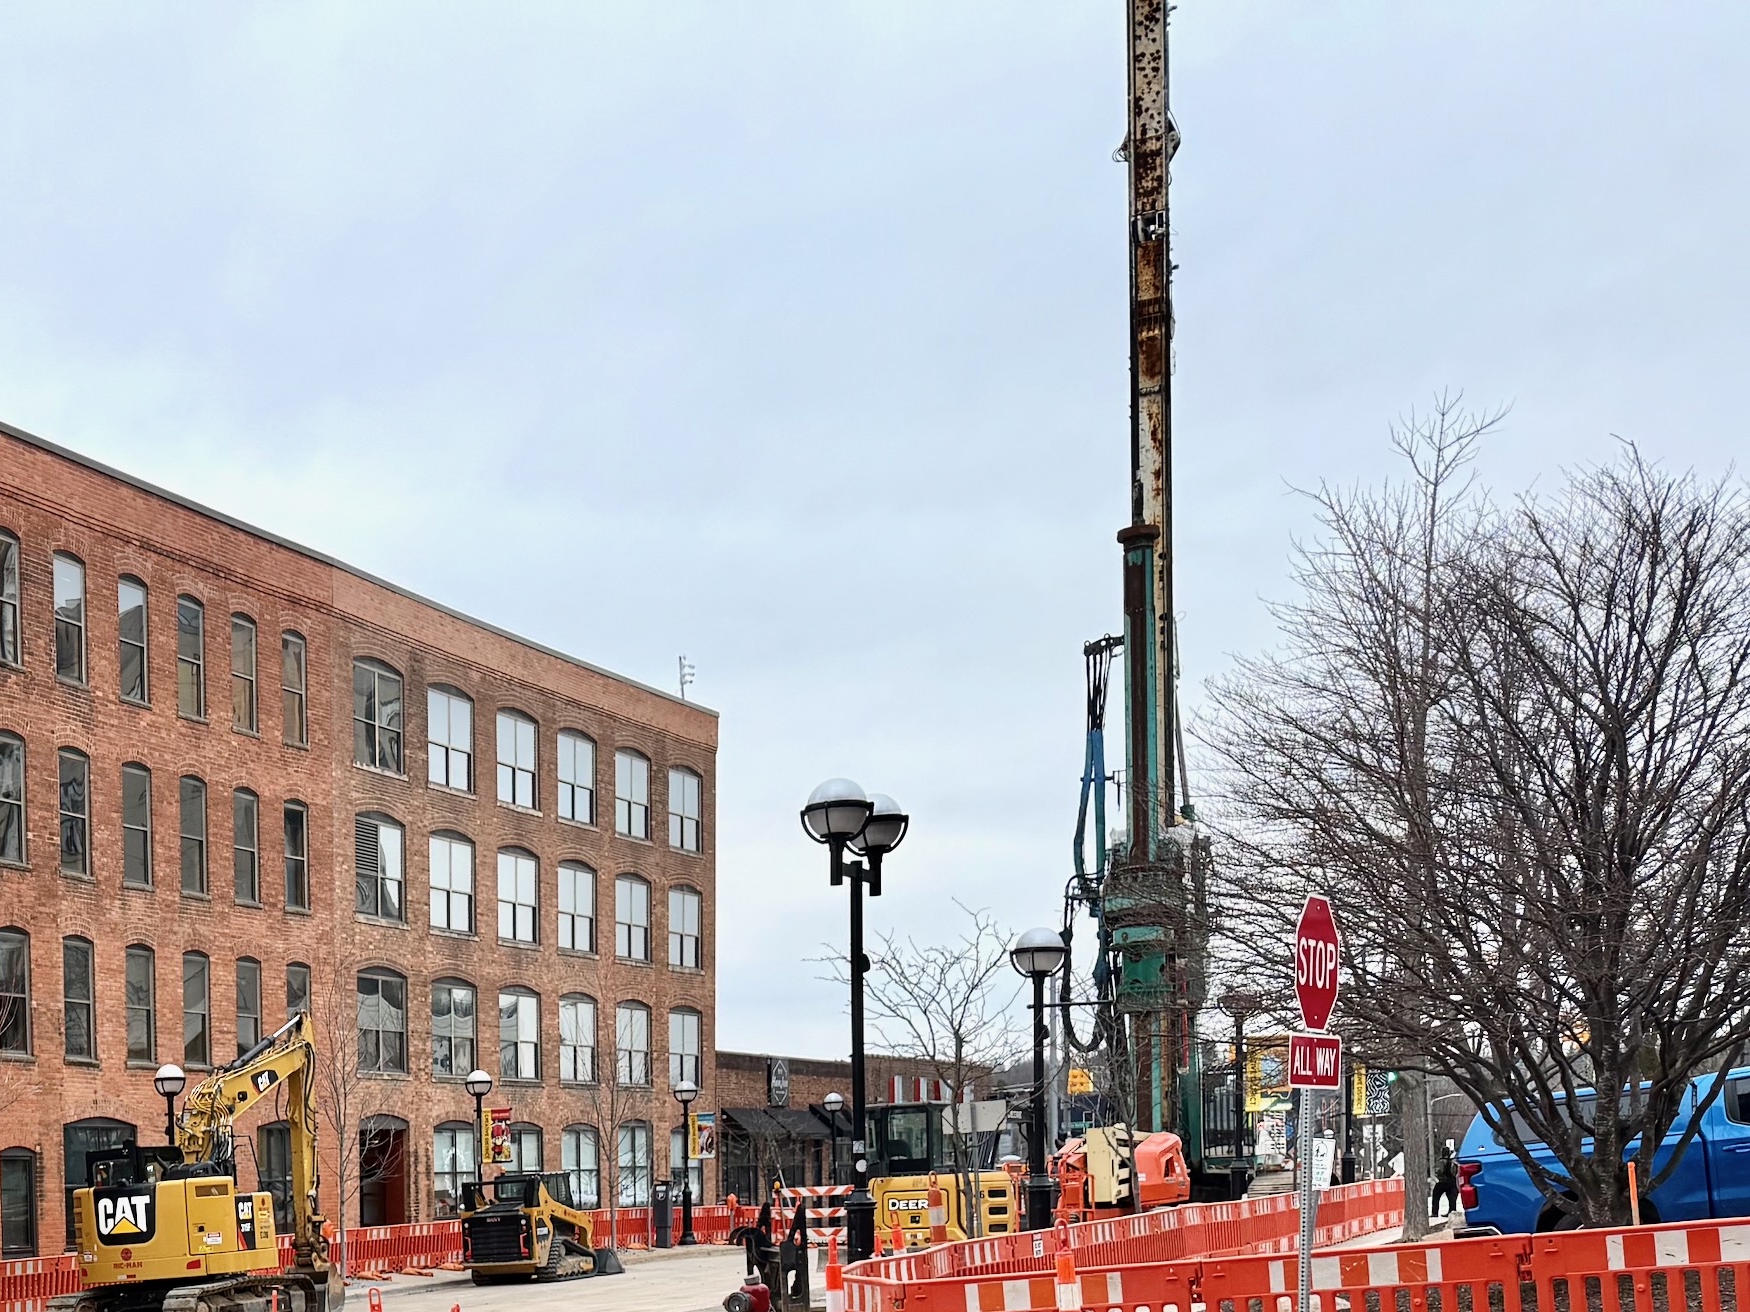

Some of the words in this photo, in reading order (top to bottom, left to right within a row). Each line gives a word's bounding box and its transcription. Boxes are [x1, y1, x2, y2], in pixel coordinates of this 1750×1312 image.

[1298, 936, 1336, 990] STOP
[1293, 1046, 1313, 1076] ALL
[1316, 1047, 1337, 1077] WAY
[98, 1195, 151, 1236] CAT
[238, 1201, 253, 1220] CAT
[888, 1198, 930, 1211] DEER
